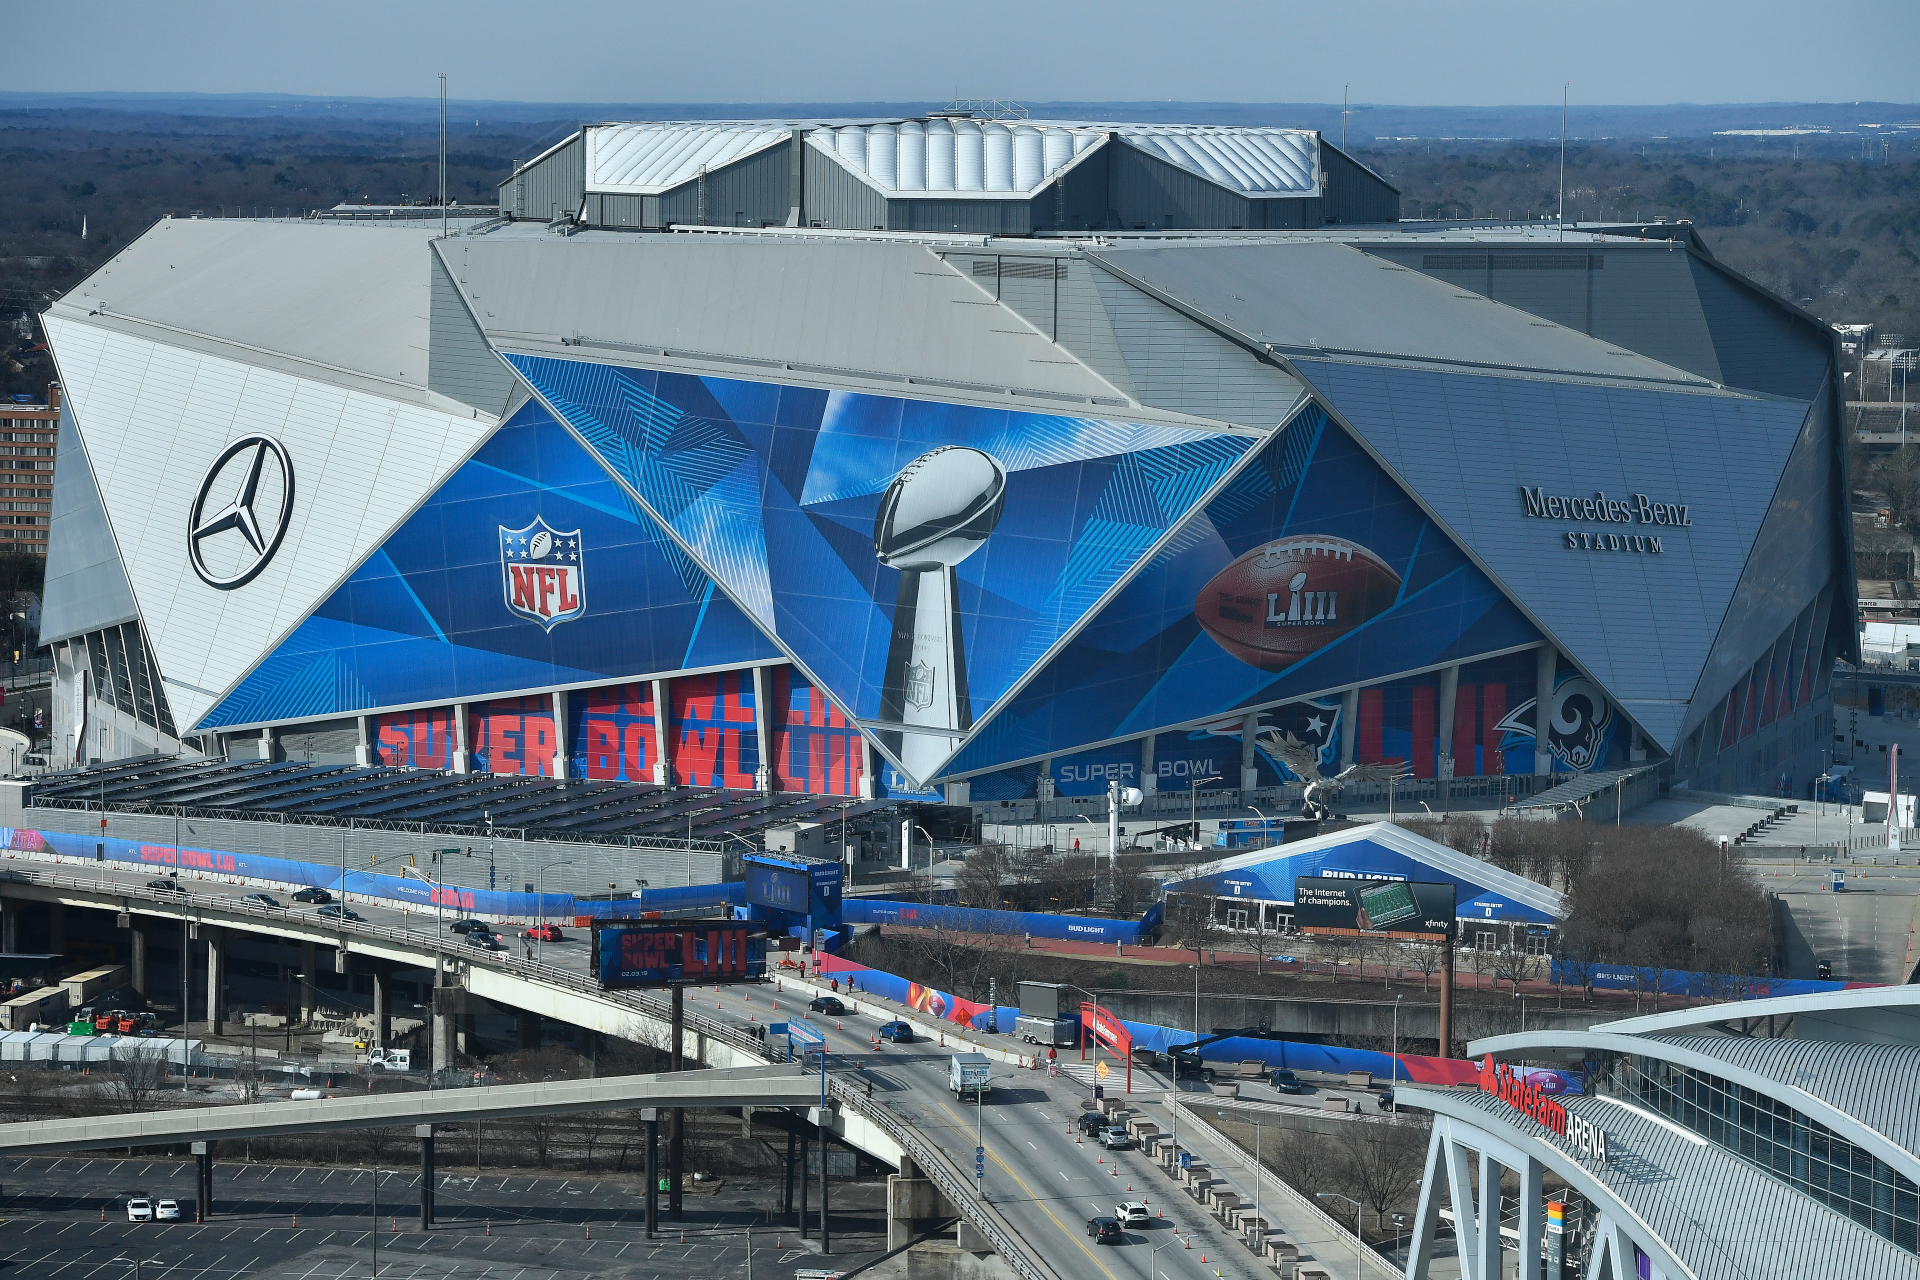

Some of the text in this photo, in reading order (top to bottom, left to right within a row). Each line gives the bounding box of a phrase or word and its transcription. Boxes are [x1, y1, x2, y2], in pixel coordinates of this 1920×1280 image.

[1521, 486, 1692, 527] Mercedes-Benz
[1567, 531, 1664, 553] STADIUM
[510, 565, 578, 617] NFL
[587, 719, 754, 790] BOWL
[1060, 759, 1221, 782] SUPER BOWL
[141, 845, 179, 864] SUPER
[181, 850, 214, 869] BOWL
[217, 854, 235, 871] LIII
[1298, 888, 1346, 898] The Internet
[1307, 897, 1352, 907] champions.
[1083, 926, 1105, 934] LIGHT
[1424, 919, 1449, 929] xfinity
[622, 929, 747, 973] SUPER LIII
[622, 951, 669, 970] BOWL
[1566, 1111, 1606, 1163] ARENA
